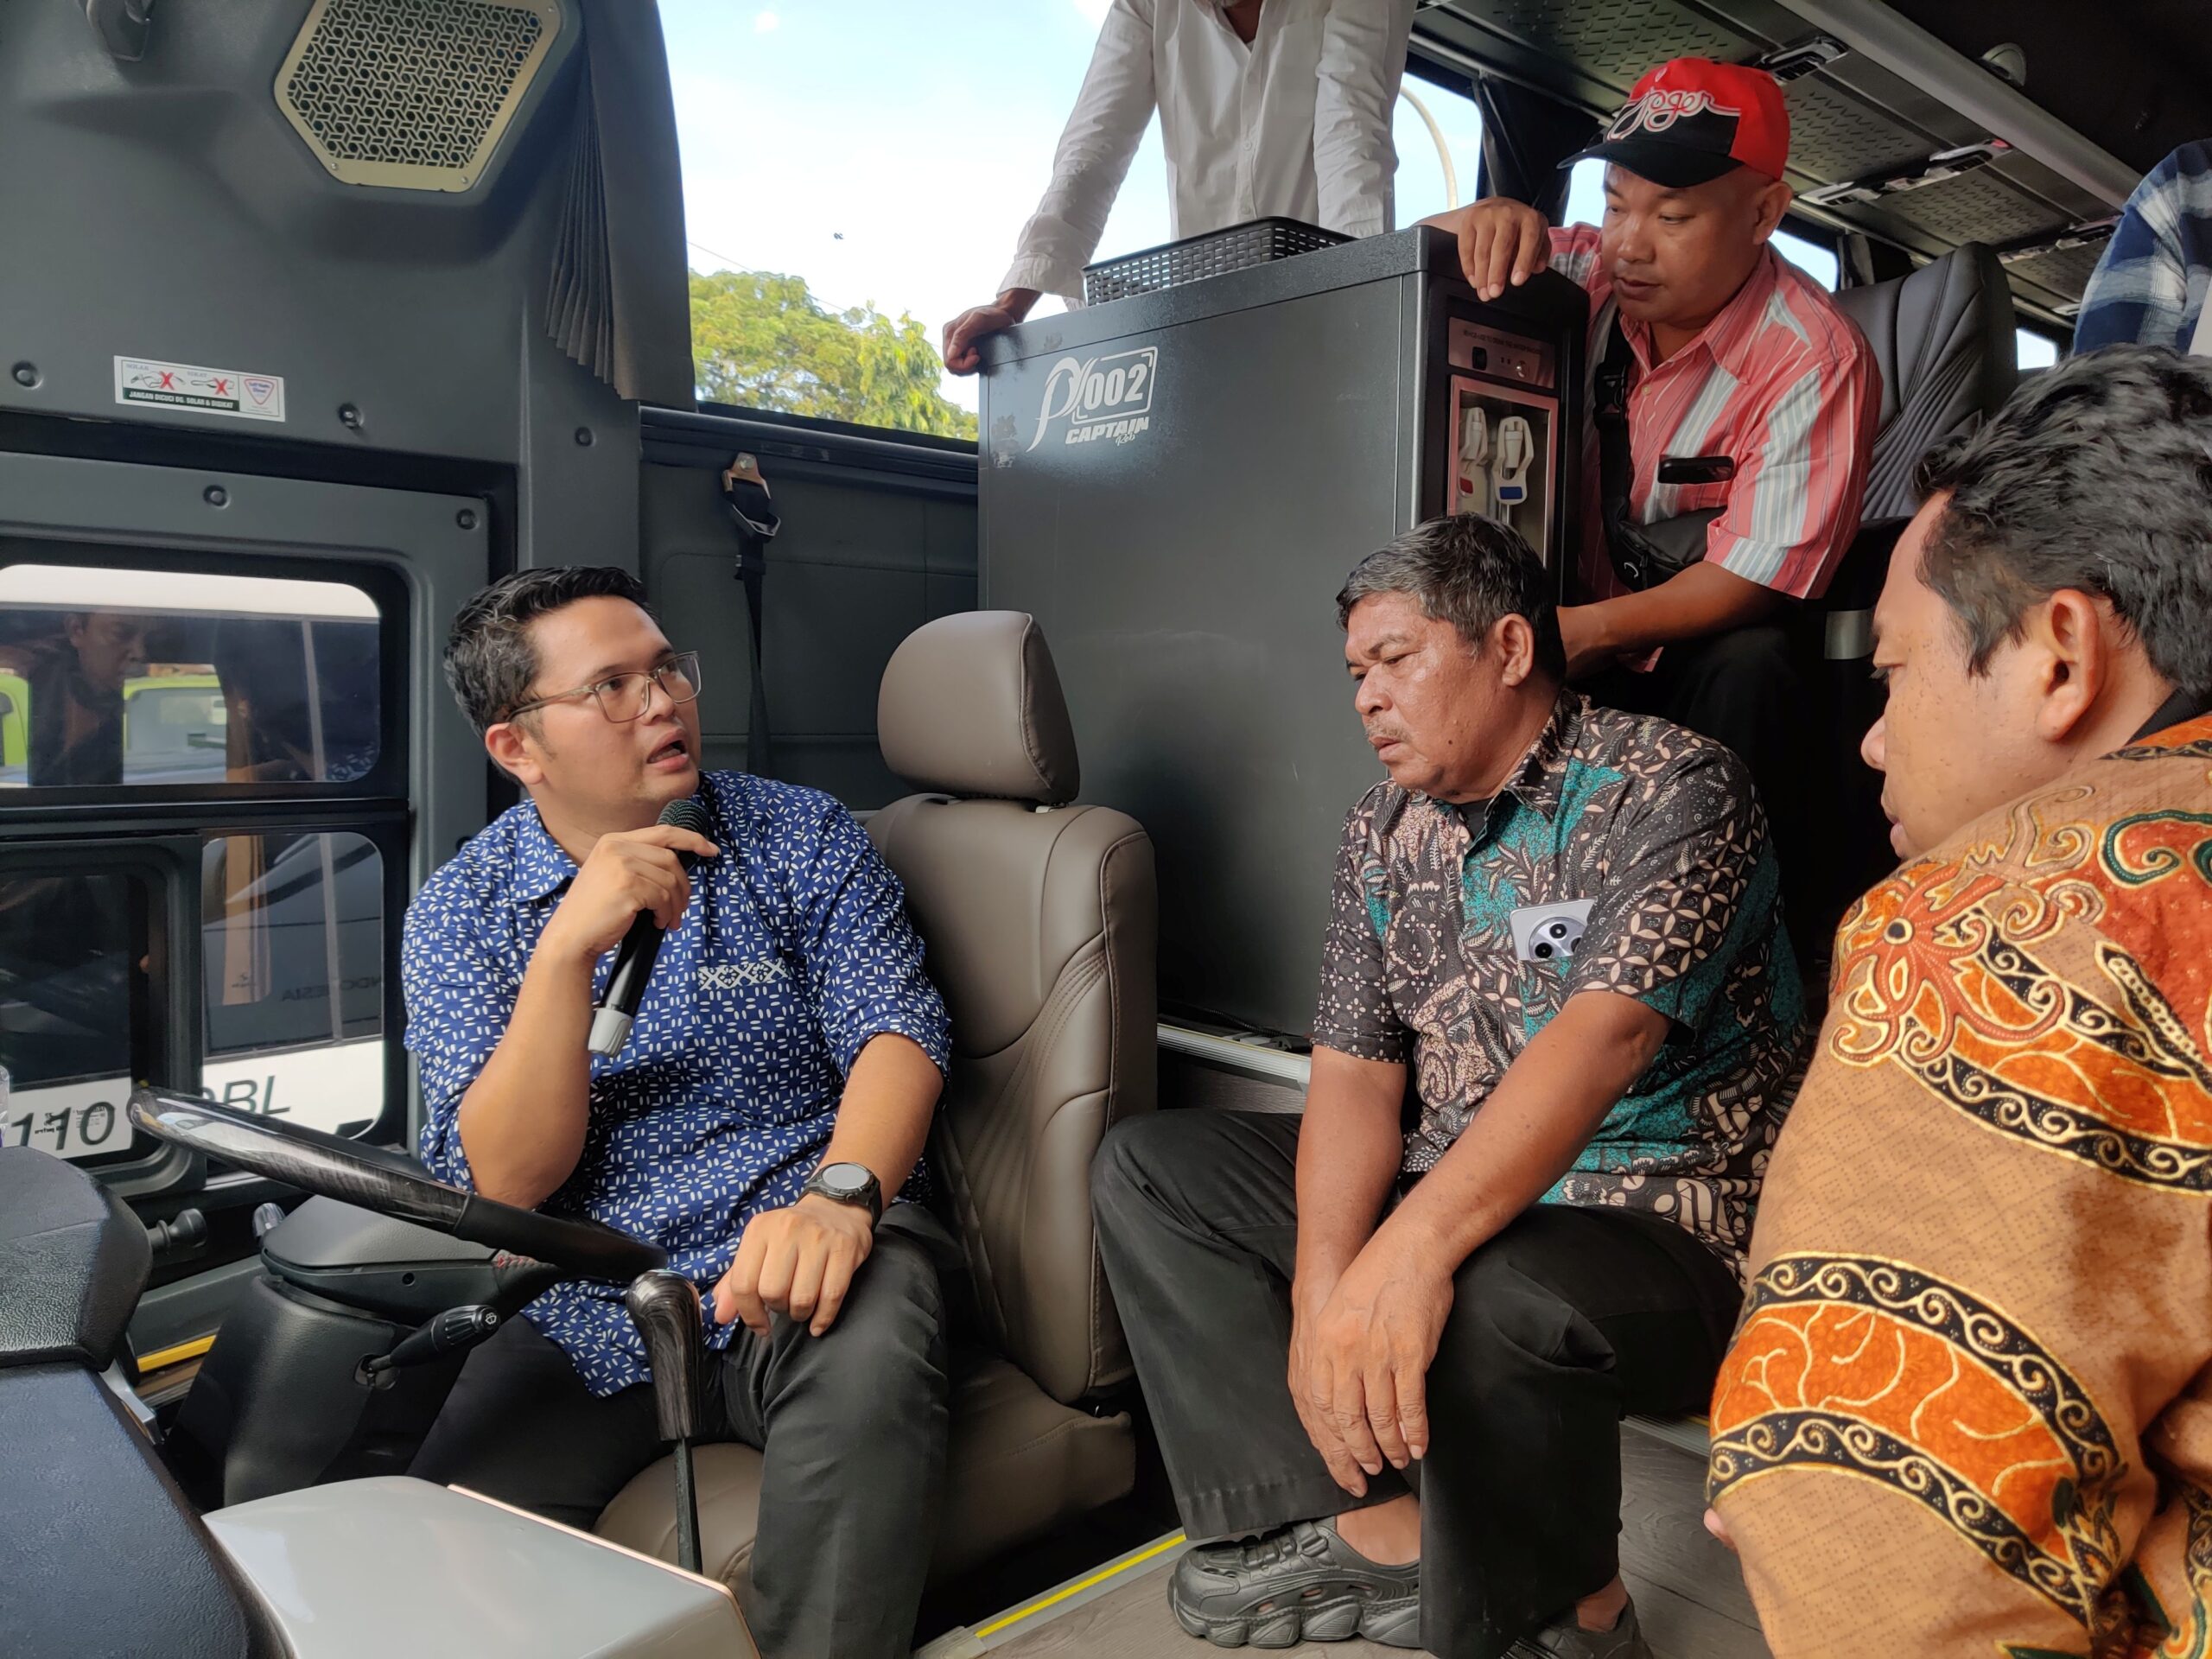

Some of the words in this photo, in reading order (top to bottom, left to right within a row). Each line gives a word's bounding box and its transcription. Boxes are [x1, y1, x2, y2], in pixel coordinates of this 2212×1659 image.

[1607, 88, 1740, 142] Joger
[129, 391, 154, 400] JANGAN
[155, 394, 175, 403] DICUCI
[187, 397, 206, 406] SOLAR
[1083, 363, 1147, 410] 002
[1065, 416, 1149, 445] CAPTAIN
